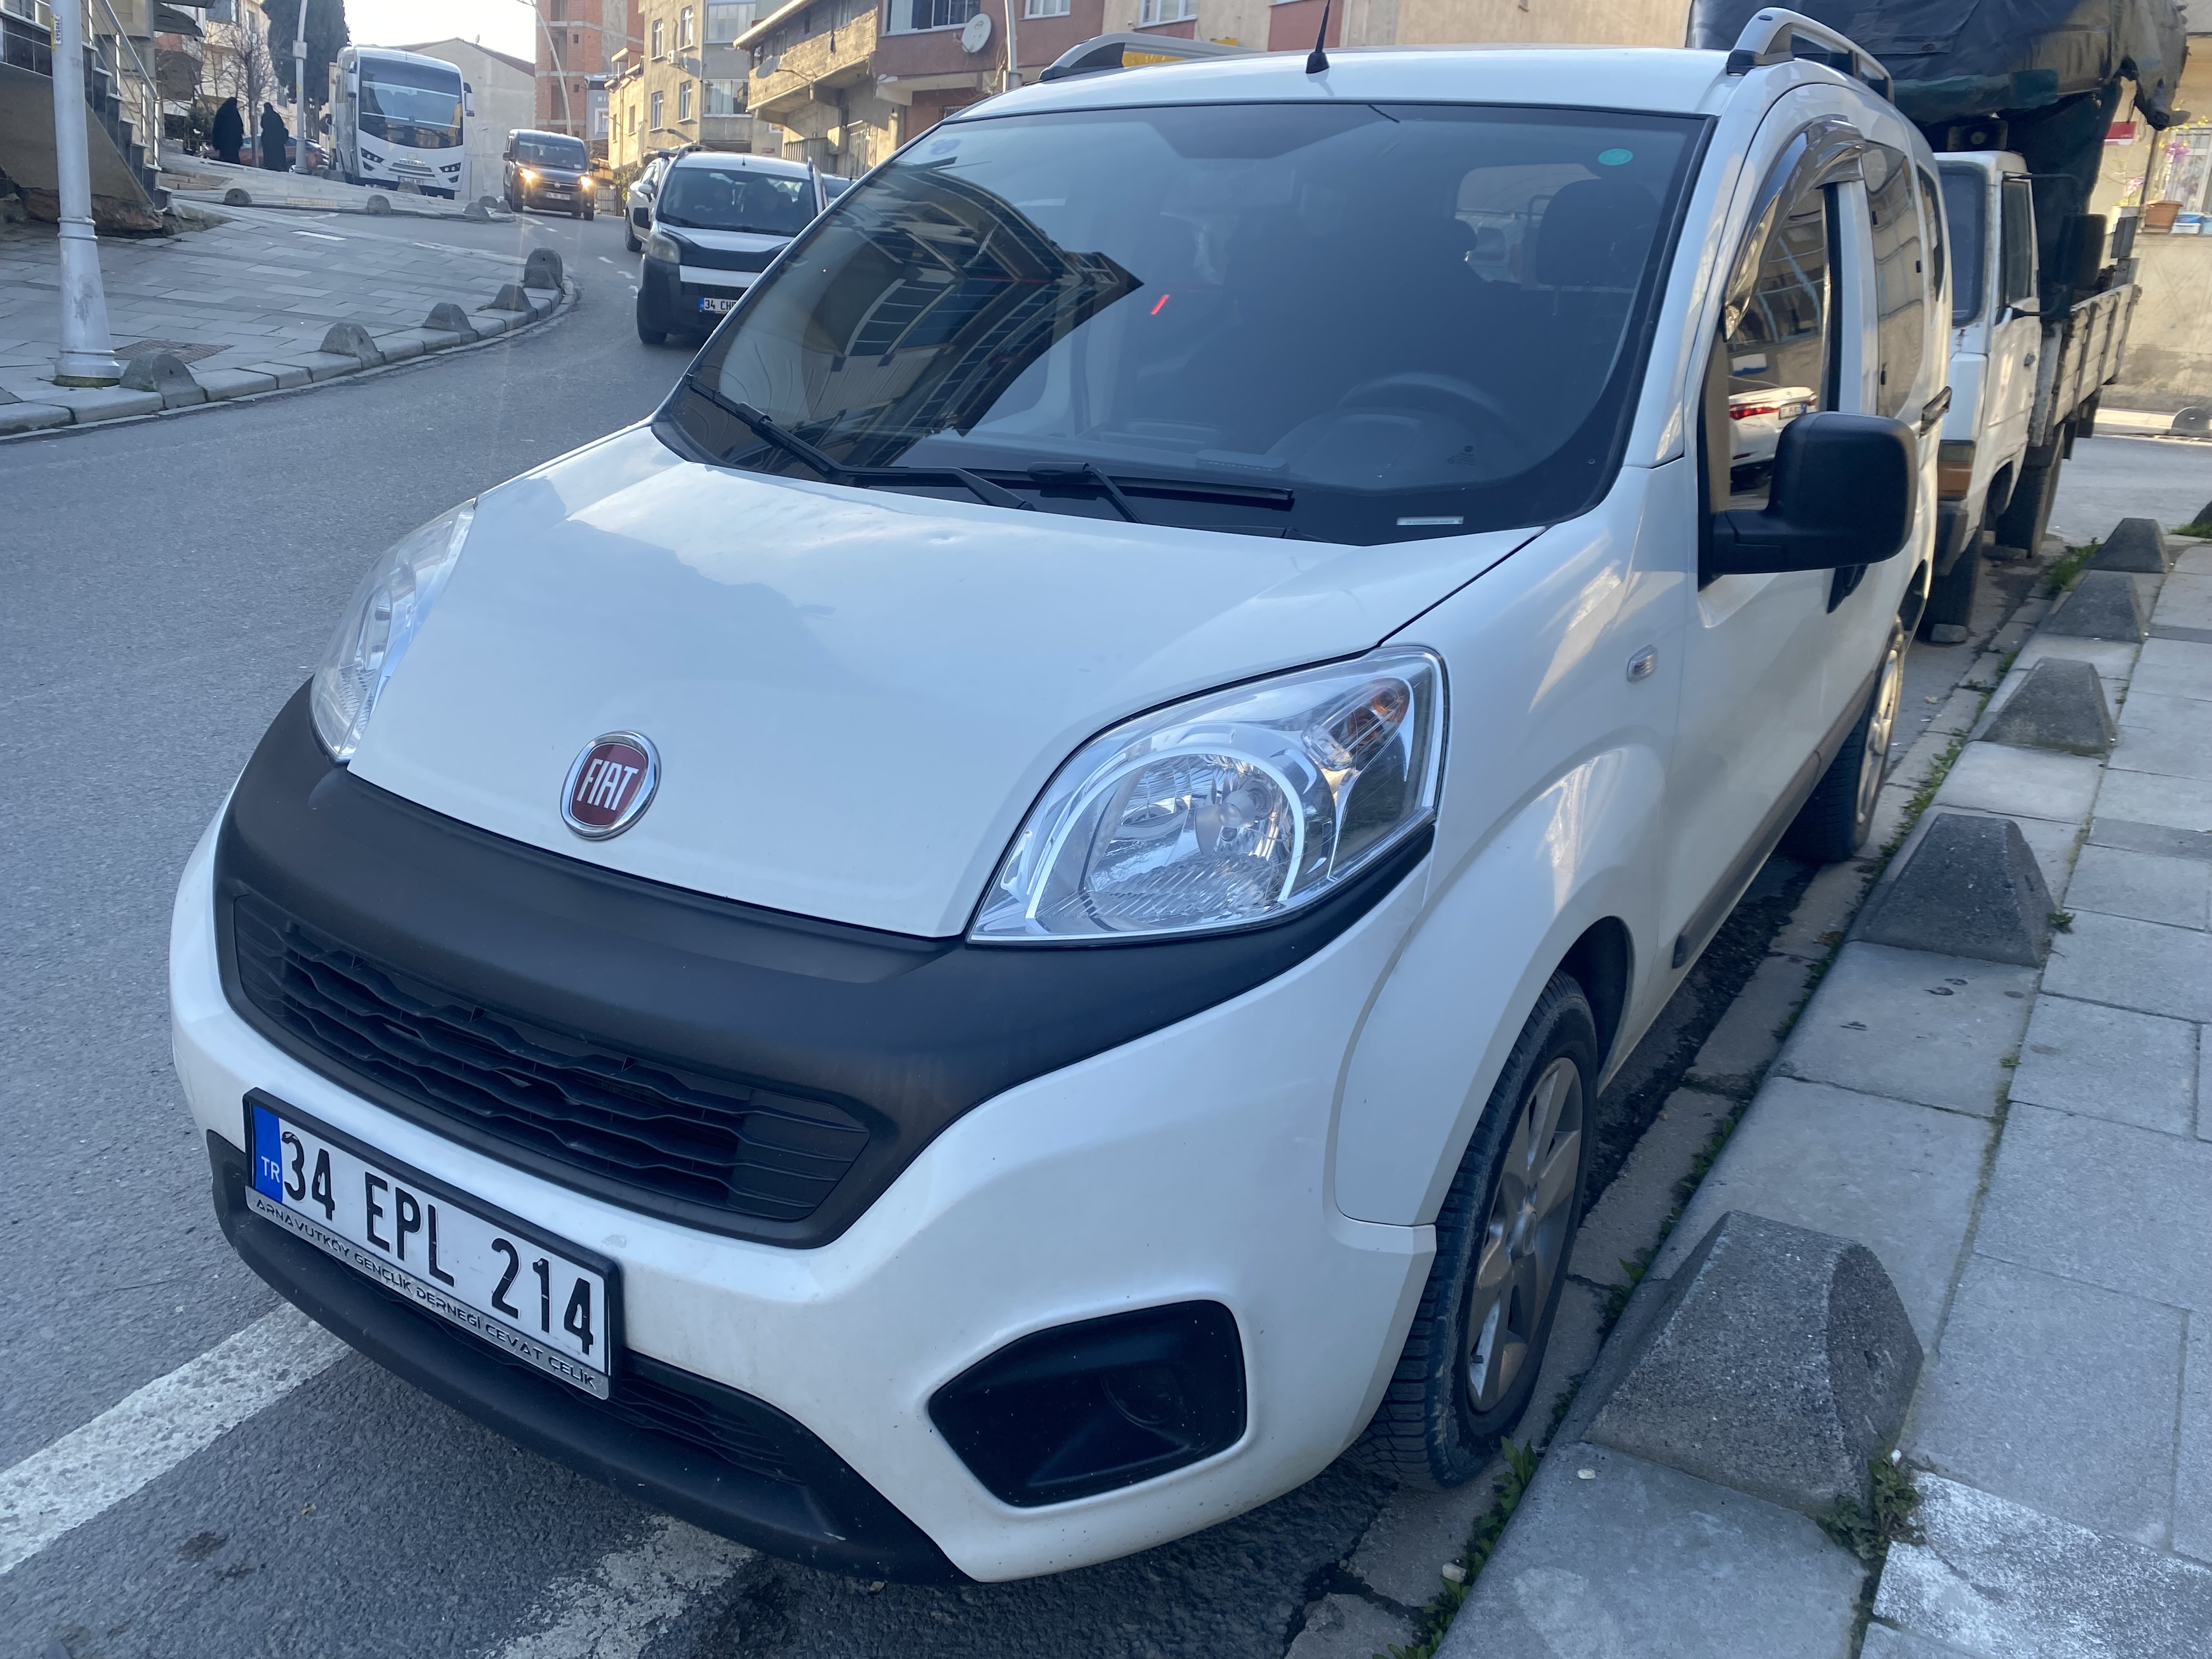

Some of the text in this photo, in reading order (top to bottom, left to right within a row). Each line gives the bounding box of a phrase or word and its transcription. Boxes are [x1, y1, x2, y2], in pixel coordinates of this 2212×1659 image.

[399, 157, 426, 166] ISUZU
[705, 300, 715, 309] 34
[577, 758, 639, 811] FIAT
[261, 1156, 280, 1183] TR
[281, 1131, 594, 1355] 34 EPL 214
[257, 1199, 596, 1390] ARNAVUTKÖY GENÇLİK DERNEĞİ CEVAT ÇELİK
